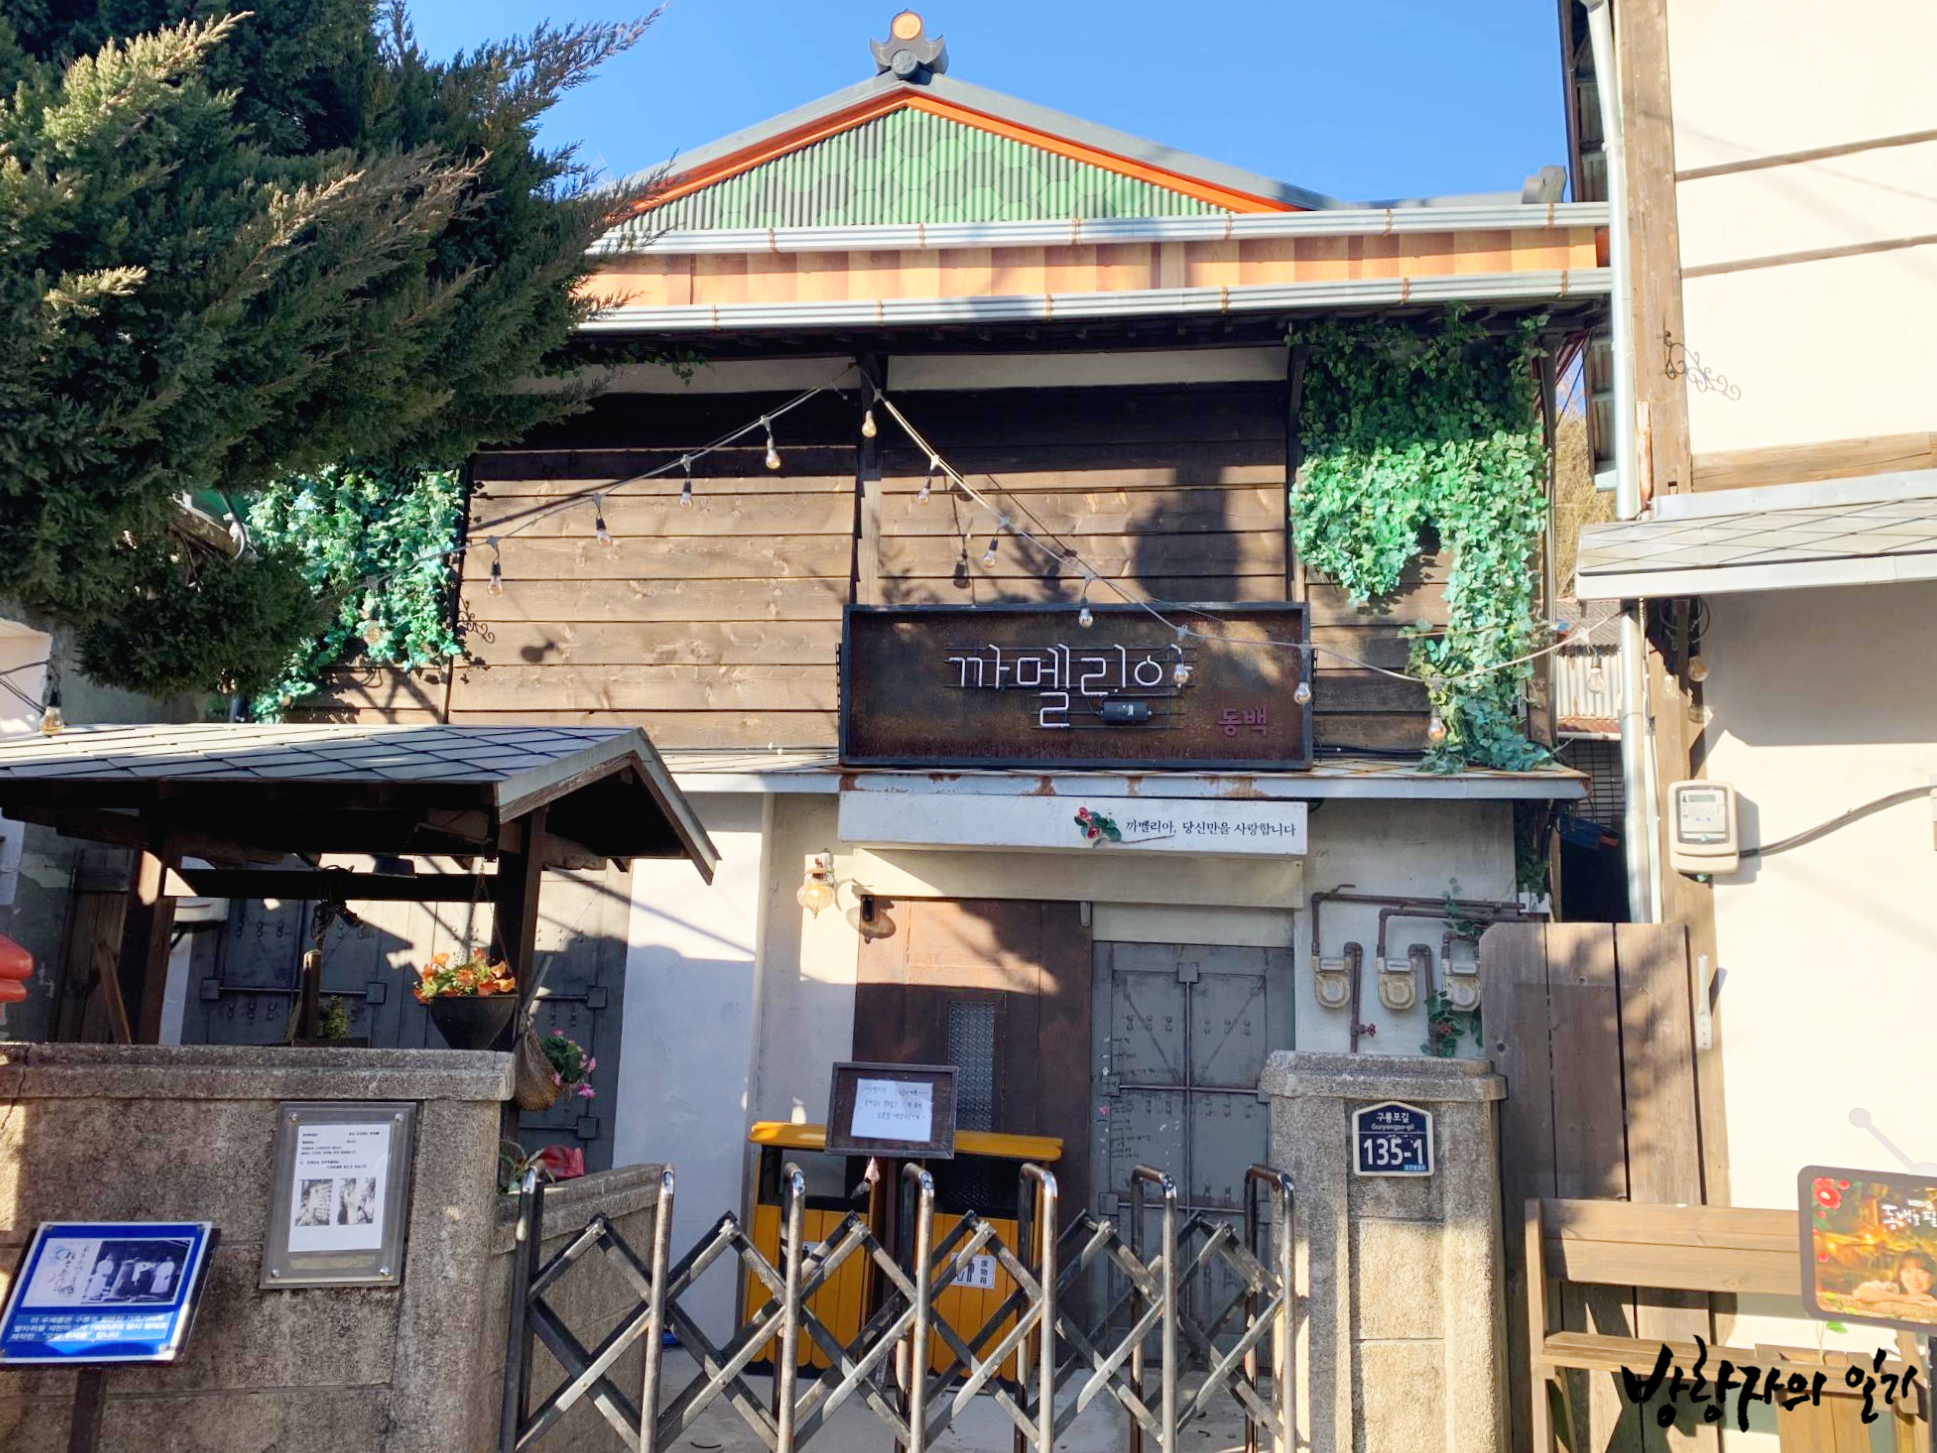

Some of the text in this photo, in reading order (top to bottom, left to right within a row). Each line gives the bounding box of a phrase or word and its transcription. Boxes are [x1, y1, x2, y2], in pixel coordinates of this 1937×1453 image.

[1217, 706, 1268, 737] 동백
[1125, 819, 1297, 837] 까멜리아, 당신만을 사랑합니다
[1376, 1112, 1409, 1124] 구룡포길
[1363, 1138, 1424, 1165] 135-1
